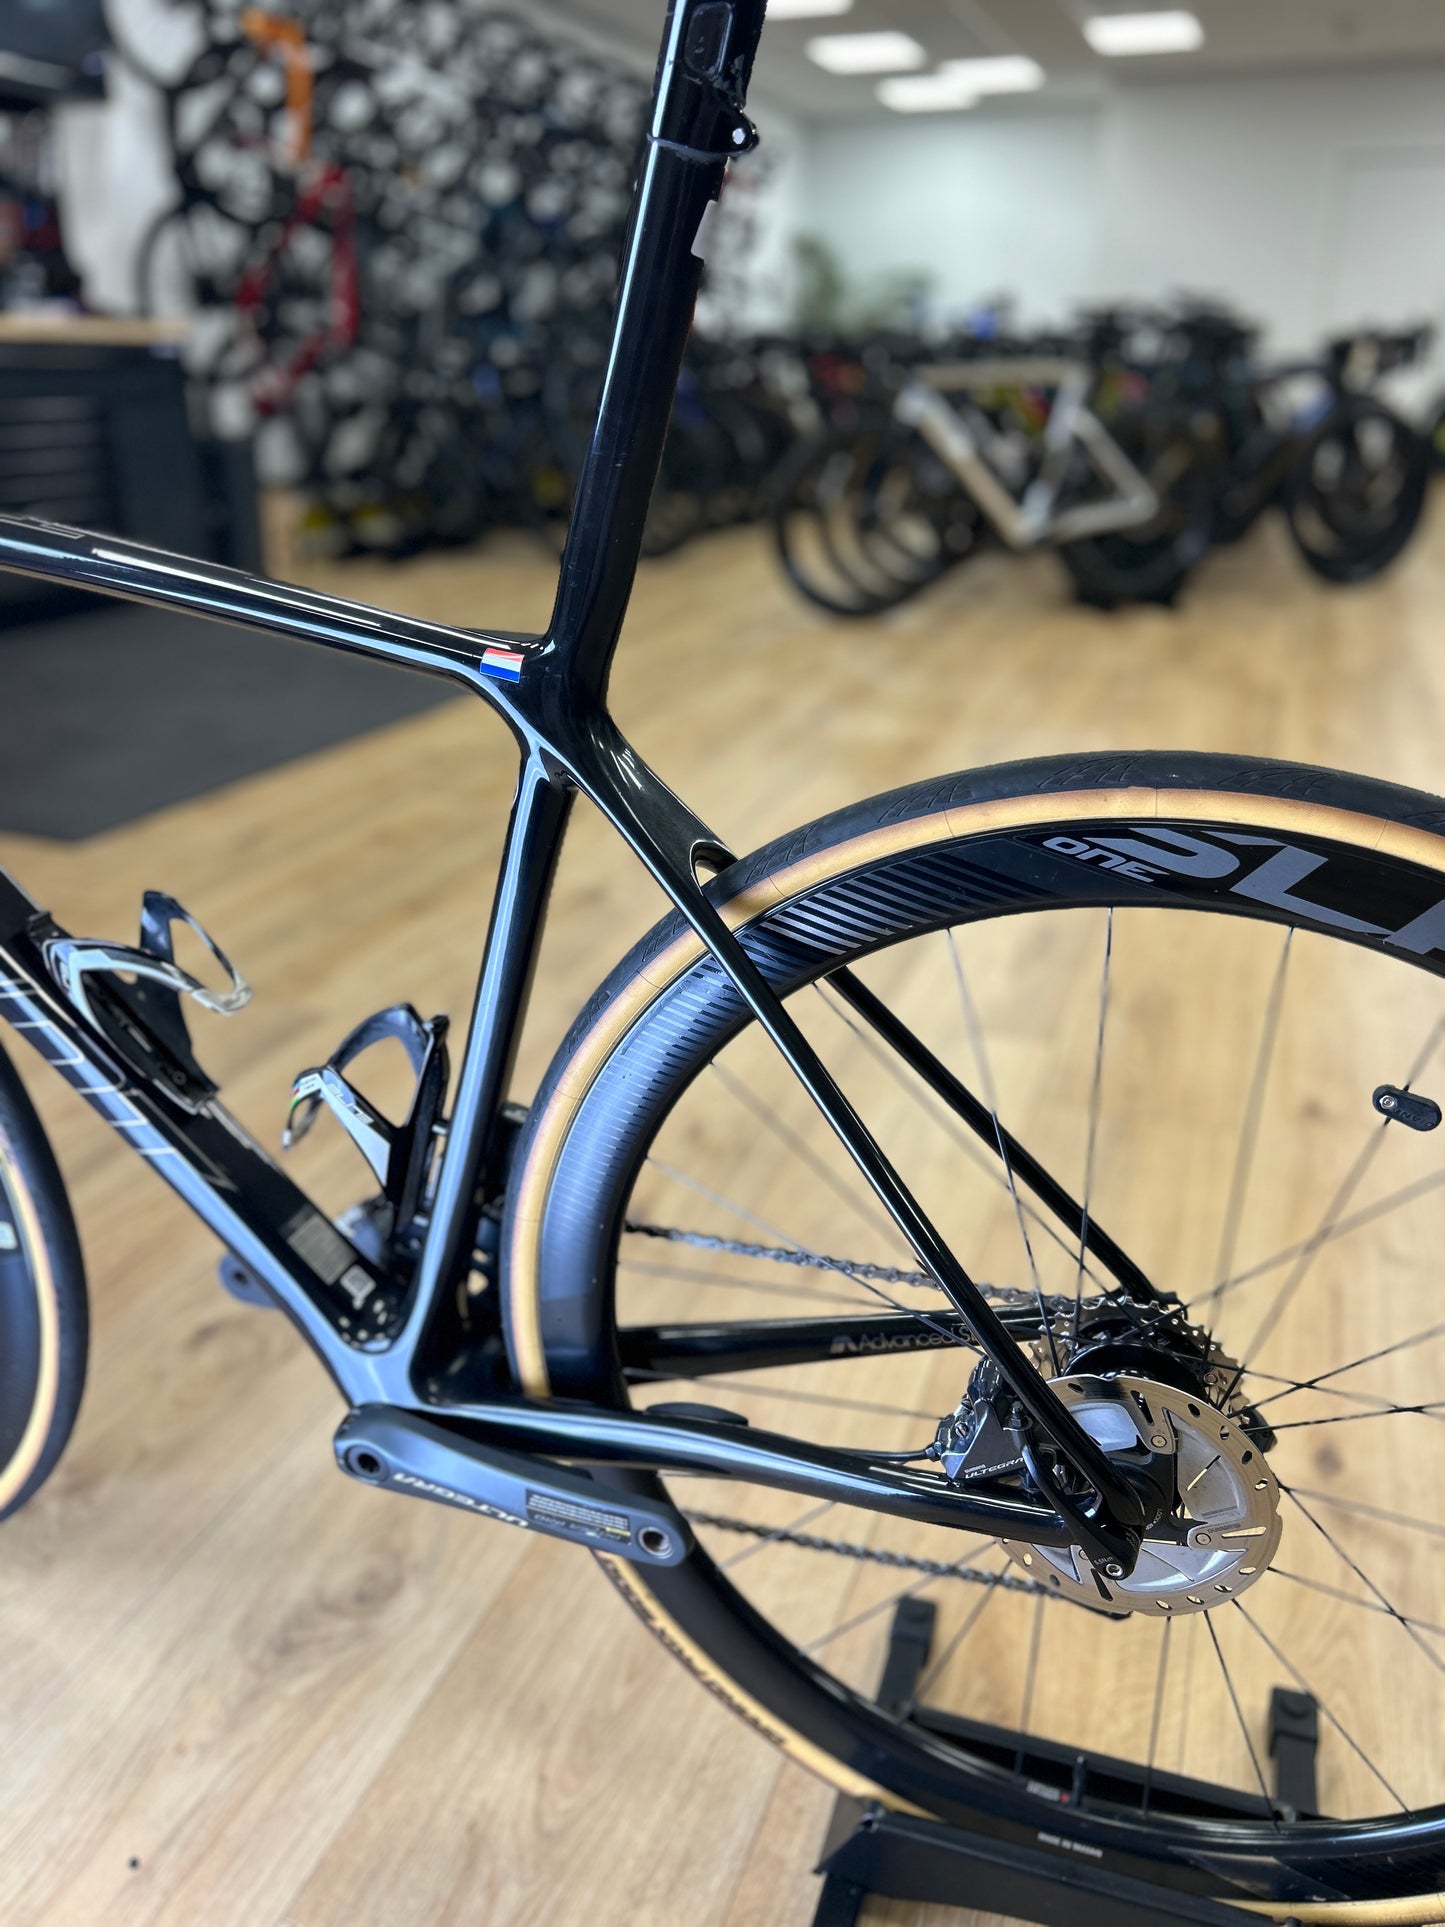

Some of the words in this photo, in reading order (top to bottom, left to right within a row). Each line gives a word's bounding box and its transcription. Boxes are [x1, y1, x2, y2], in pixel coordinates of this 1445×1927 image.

[326, 1082, 374, 1125] ELITE
[859, 1327, 956, 1351] Advanced
[964, 1457, 1024, 1480] ULTEGRA
[393, 1472, 529, 1528] ULTEGRA
